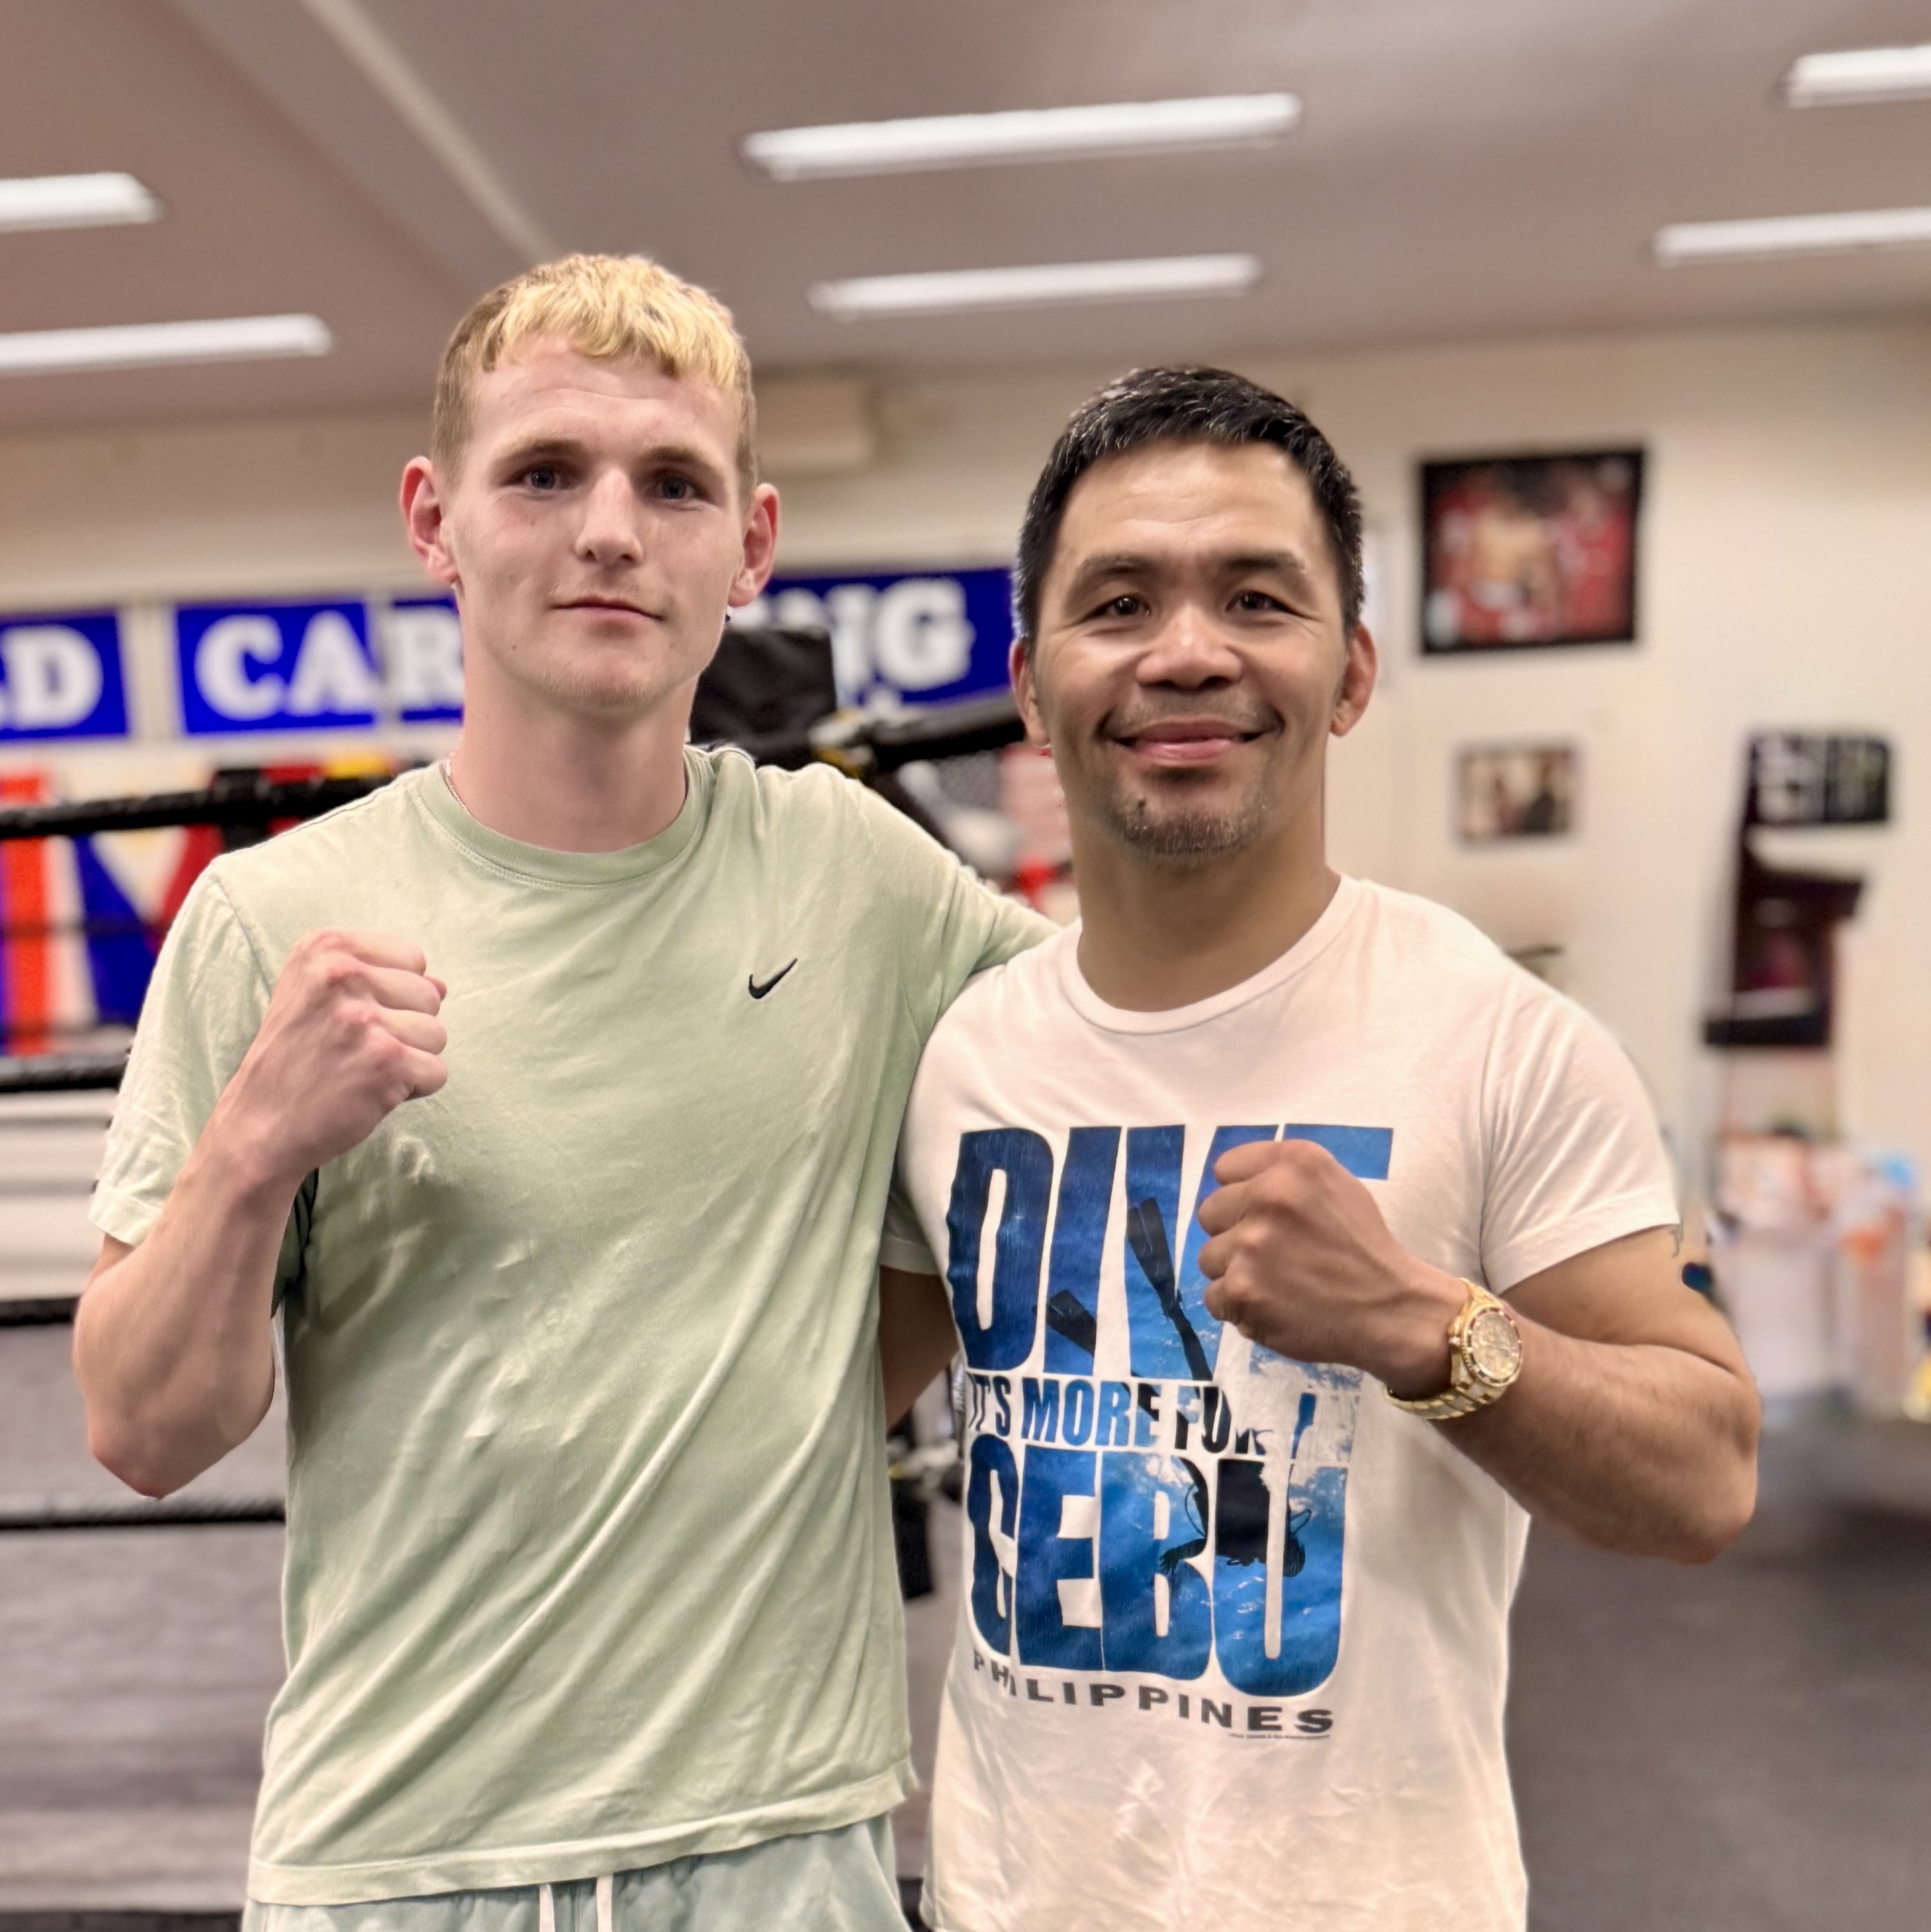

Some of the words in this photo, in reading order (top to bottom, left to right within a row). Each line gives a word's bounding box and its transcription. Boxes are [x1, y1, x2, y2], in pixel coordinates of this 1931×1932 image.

[1021, 1376, 1162, 1448] MORE
[968, 1433, 1349, 1697] CEBU
[973, 1648, 1334, 1734] PHILIPPINES
